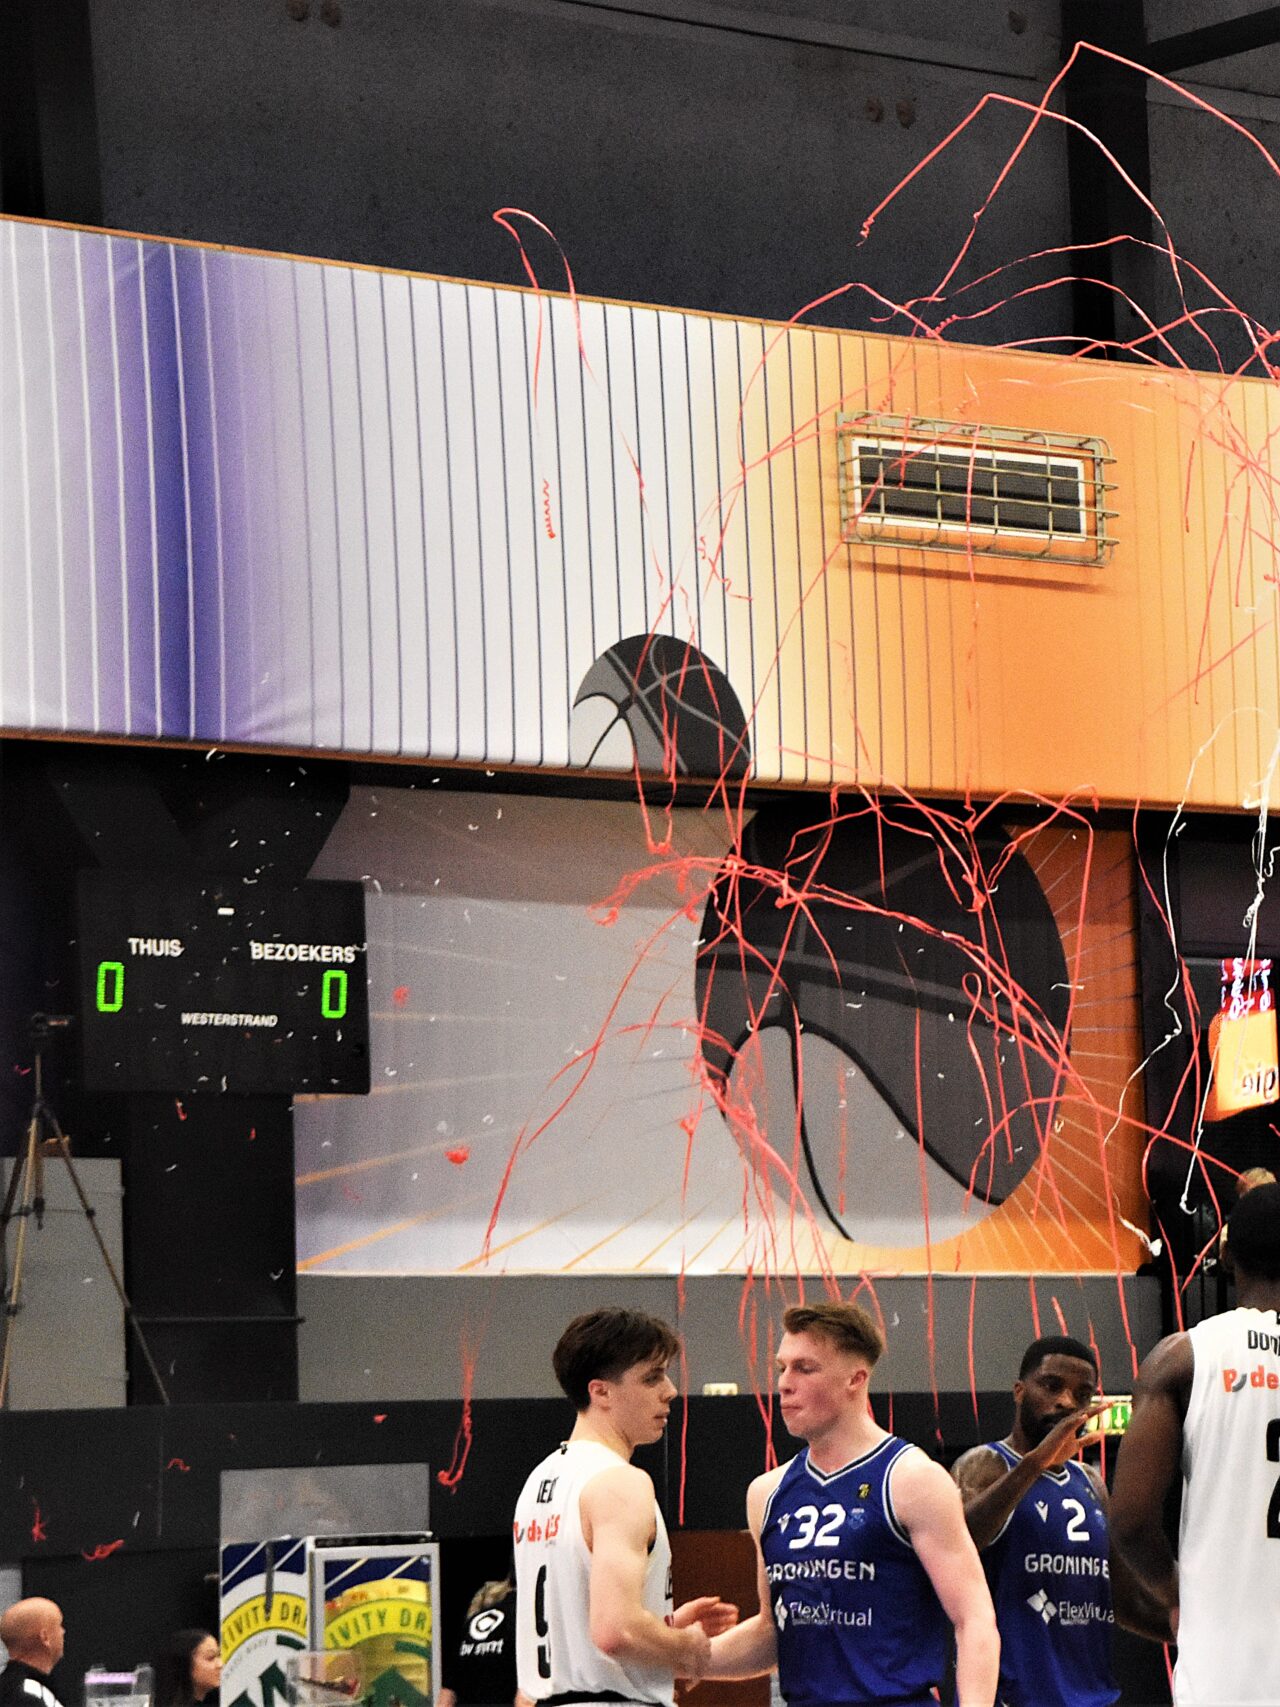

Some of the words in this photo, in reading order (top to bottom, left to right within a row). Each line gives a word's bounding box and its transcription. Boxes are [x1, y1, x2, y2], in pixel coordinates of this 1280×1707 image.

[128, 938, 183, 957] THUIS
[251, 943, 355, 963] BEZOEKERS
[96, 962, 124, 1012] 0
[321, 970, 347, 1018] 0
[181, 1012, 278, 1027] WESTERSTRAND
[1251, 1365, 1279, 1390] de
[789, 1503, 846, 1549] 32
[1062, 1498, 1090, 1541] 2
[765, 1559, 875, 1584] GRONINGEN
[400, 1608, 431, 1633] DR
